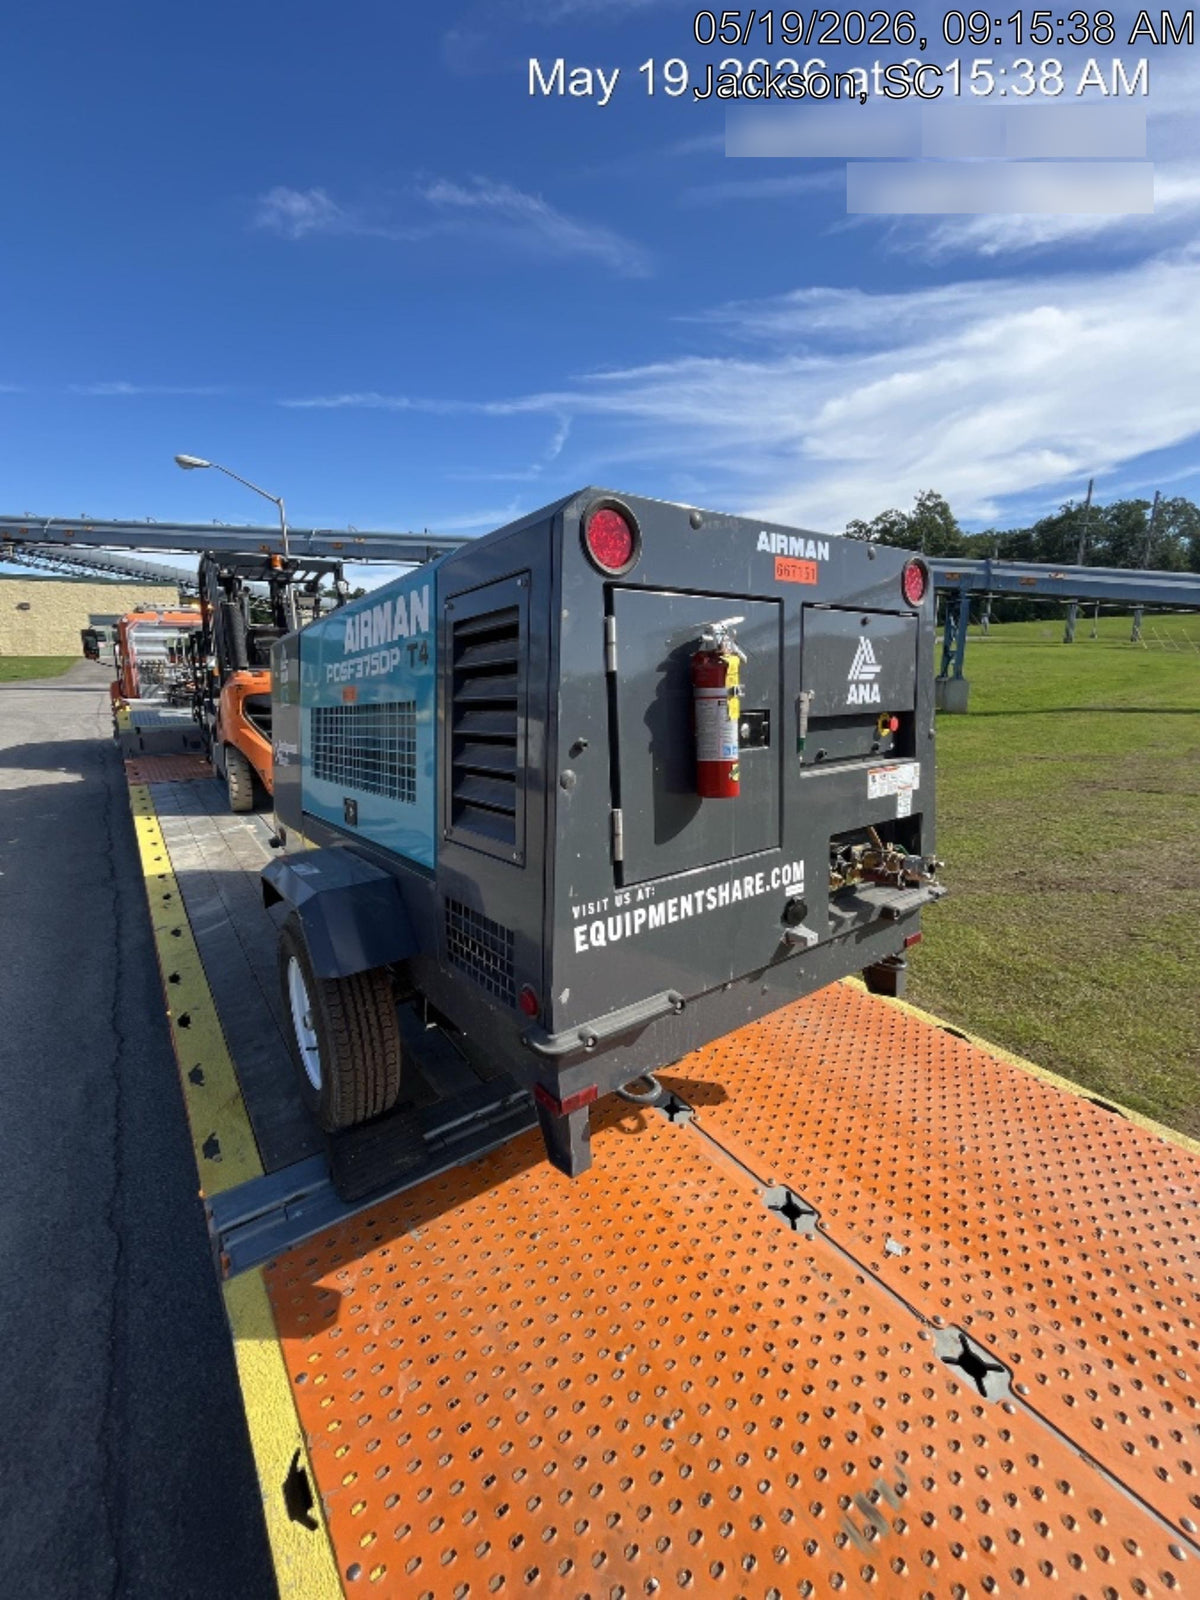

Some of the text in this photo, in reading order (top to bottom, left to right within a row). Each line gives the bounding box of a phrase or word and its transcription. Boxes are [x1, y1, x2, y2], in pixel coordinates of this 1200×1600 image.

[757, 531, 829, 561] AIRMAN
[344, 584, 429, 655] AIRMAN
[406, 641, 428, 668] T4
[846, 683, 881, 705] ANA
[572, 886, 656, 920] VISIT US AT:
[573, 860, 805, 954] EQUIPMENTSHARE.COM
